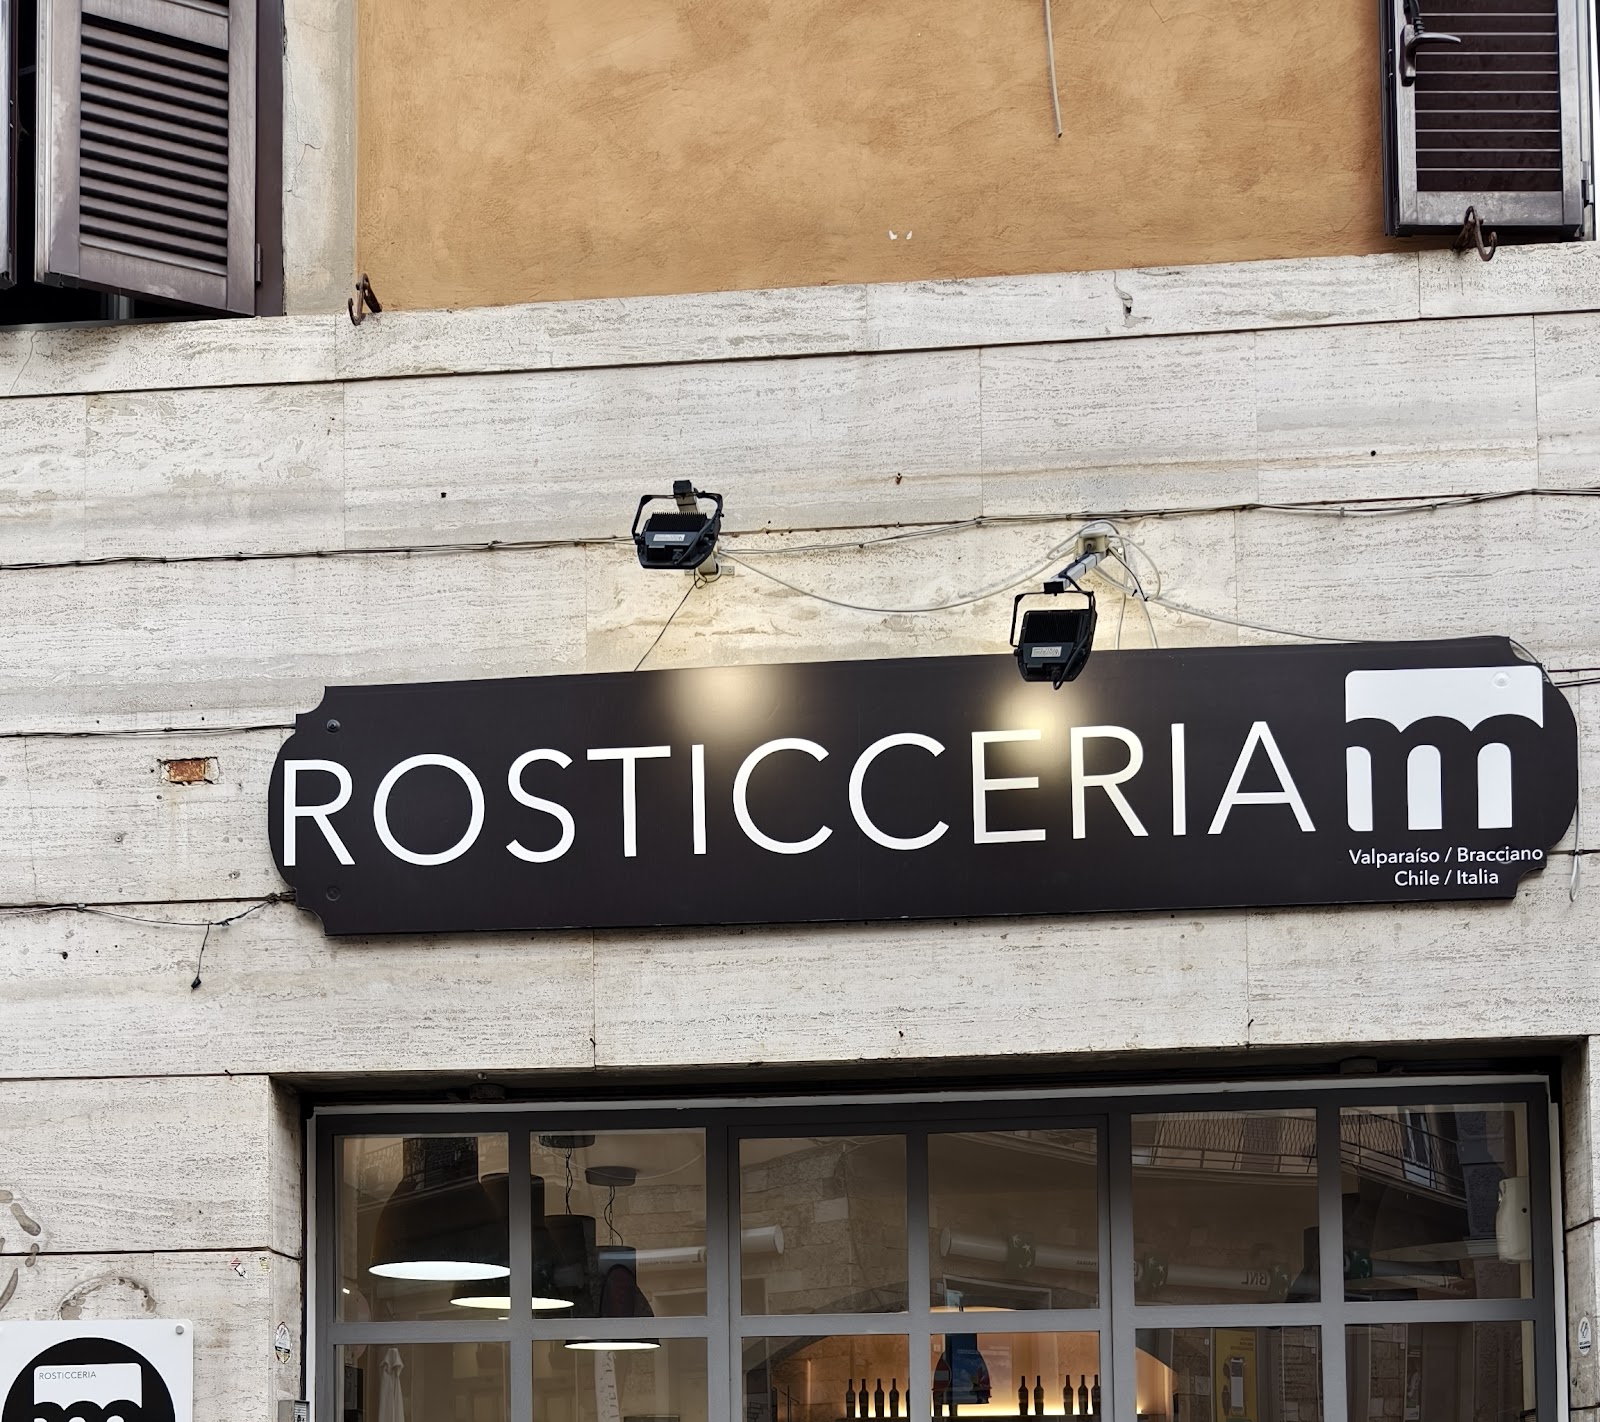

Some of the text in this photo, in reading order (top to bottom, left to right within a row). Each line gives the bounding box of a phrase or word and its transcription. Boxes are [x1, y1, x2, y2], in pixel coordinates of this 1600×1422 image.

[282, 719, 1318, 867] ROSTICCERIA
[1348, 847, 1440, 867] Valparaíso
[1457, 847, 1543, 863] Bracciano
[1394, 870, 1440, 886] Chile
[1457, 870, 1499, 885] Italia
[39, 1371, 97, 1380] ROSTICCERIA
